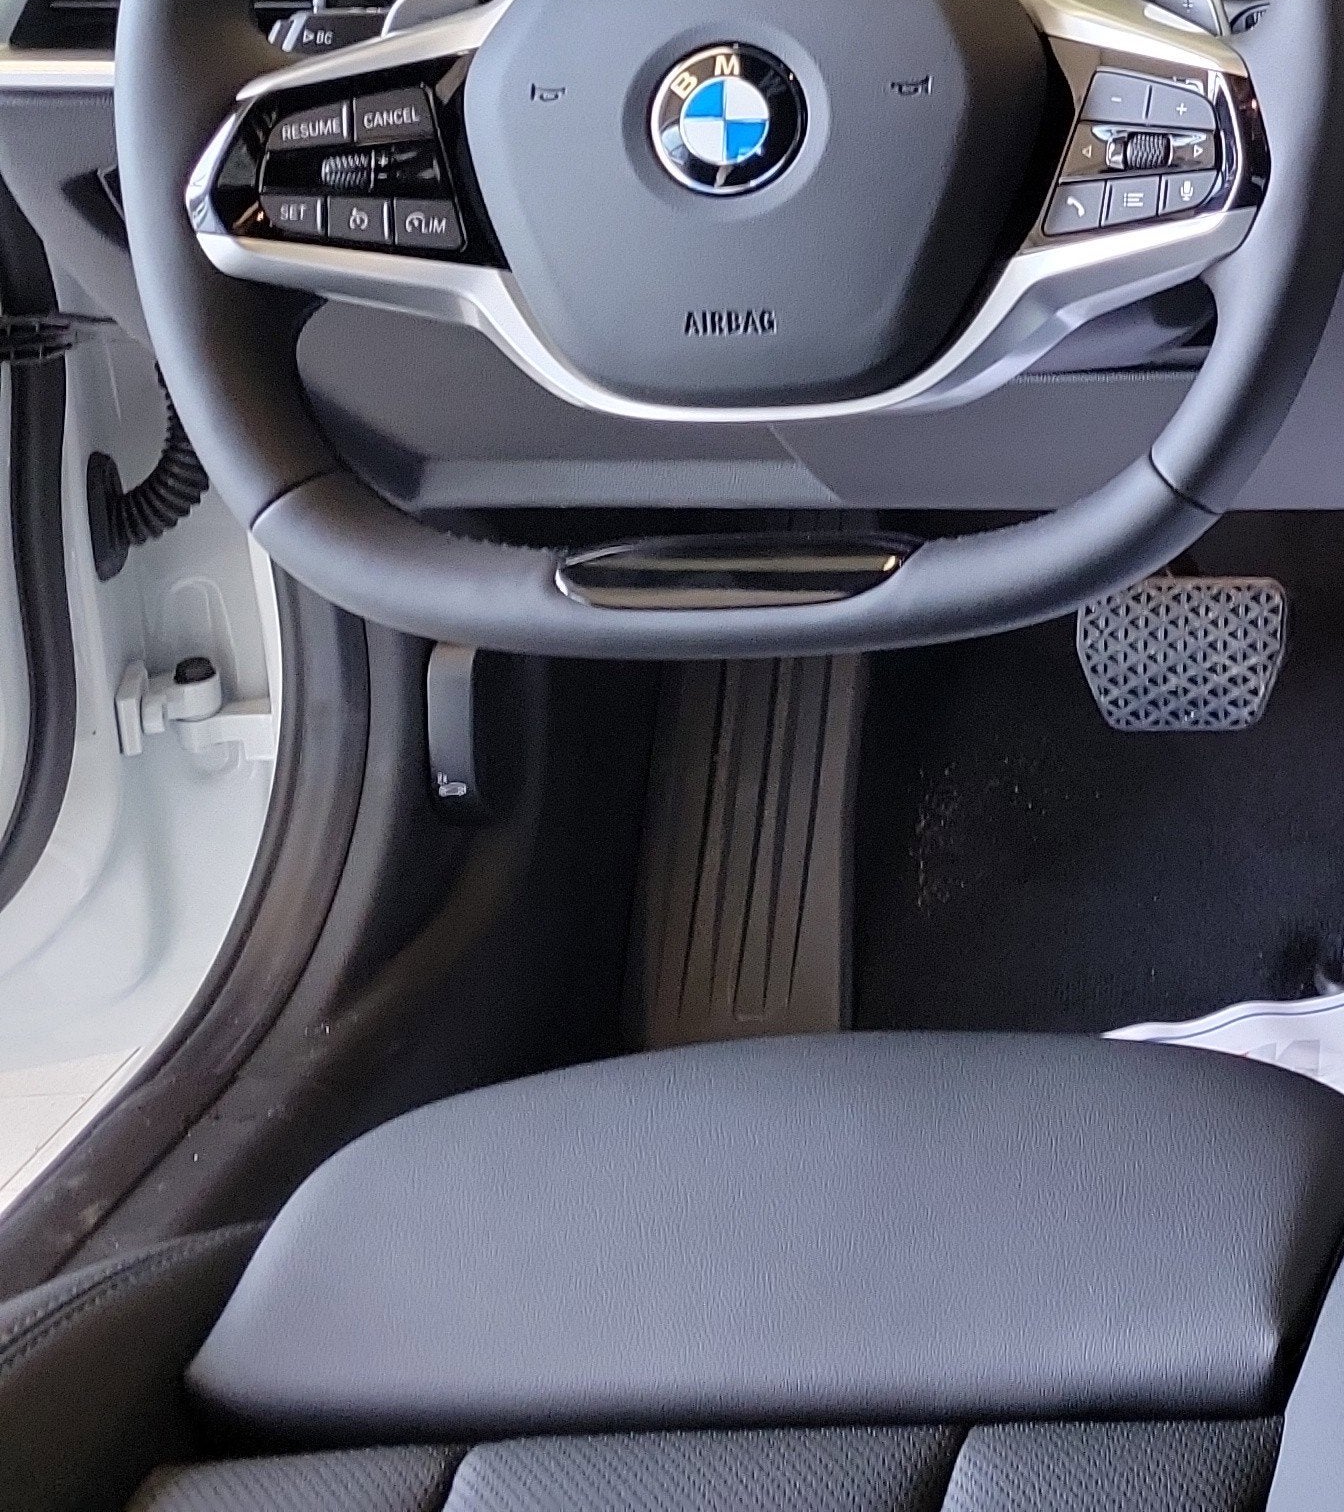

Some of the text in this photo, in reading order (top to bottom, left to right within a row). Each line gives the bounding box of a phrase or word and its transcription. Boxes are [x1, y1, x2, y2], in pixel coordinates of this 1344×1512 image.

[281, 116, 341, 142] RESUME
[363, 105, 421, 130] CANCEL
[280, 202, 308, 221] SET
[421, 216, 447, 234] LIM
[684, 309, 778, 336] AIRBAG
